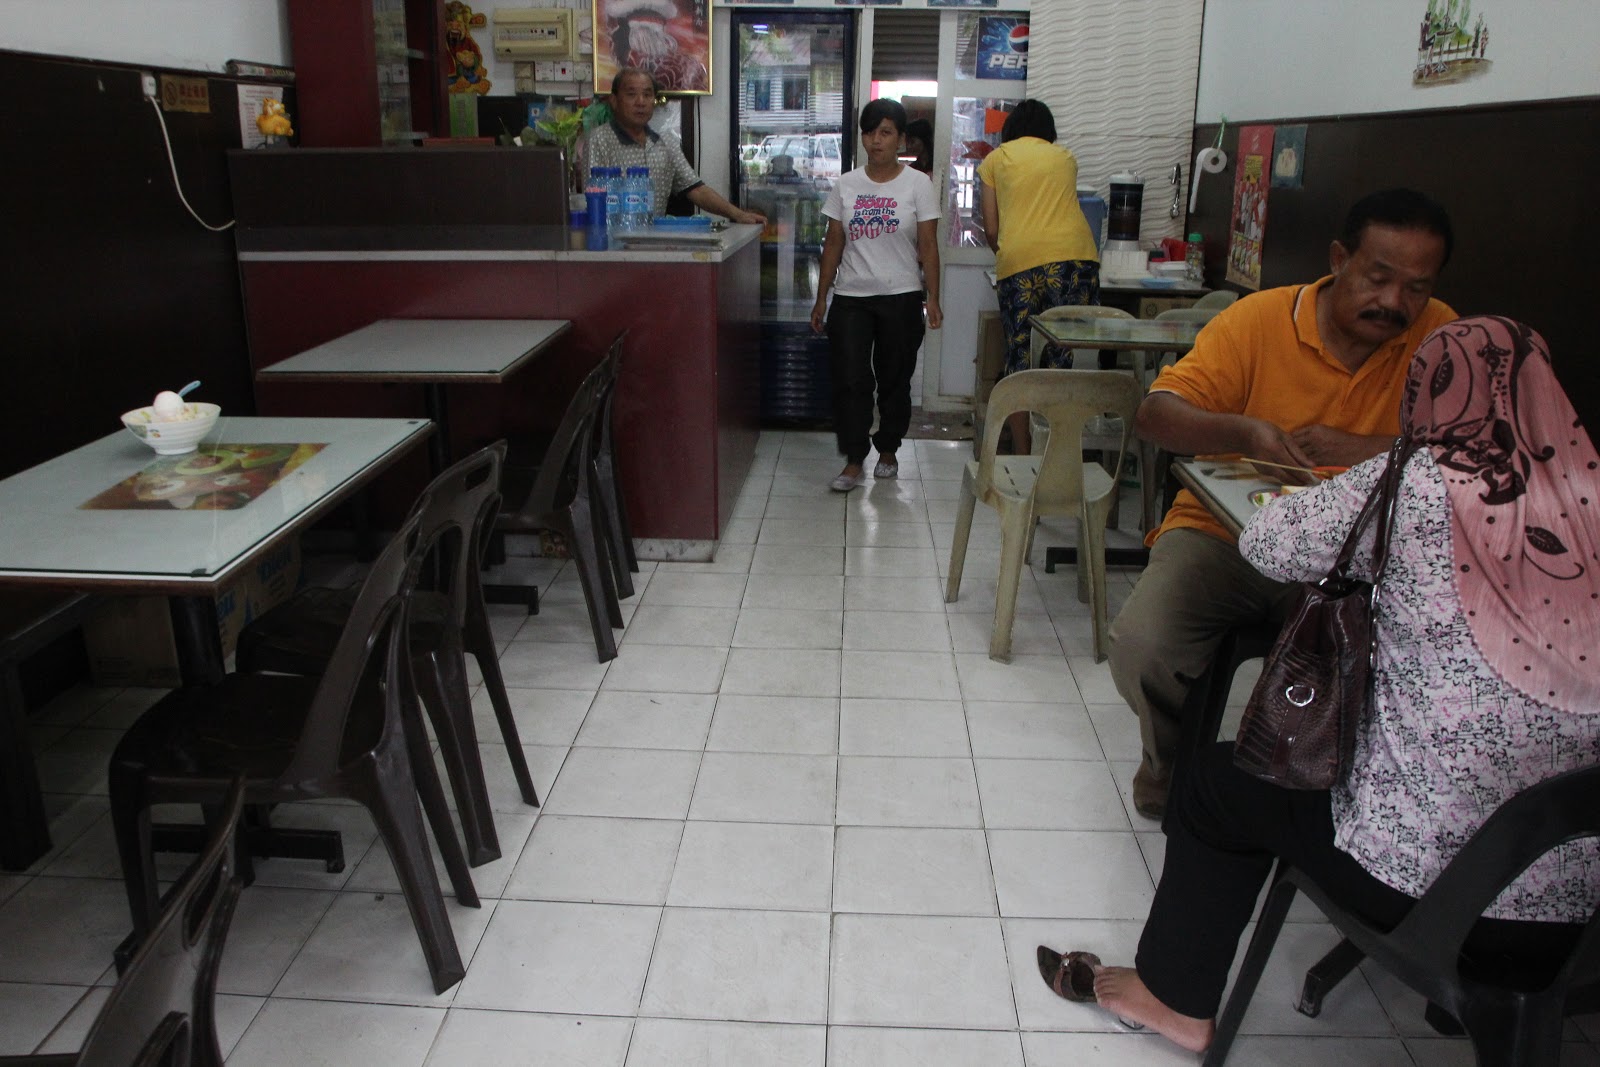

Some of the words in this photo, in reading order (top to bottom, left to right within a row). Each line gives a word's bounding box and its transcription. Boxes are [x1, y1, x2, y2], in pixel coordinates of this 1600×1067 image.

[853, 198, 898, 209] SOUL
[854, 210, 861, 218] is
[861, 208, 881, 216] from
[882, 207, 896, 216] the
